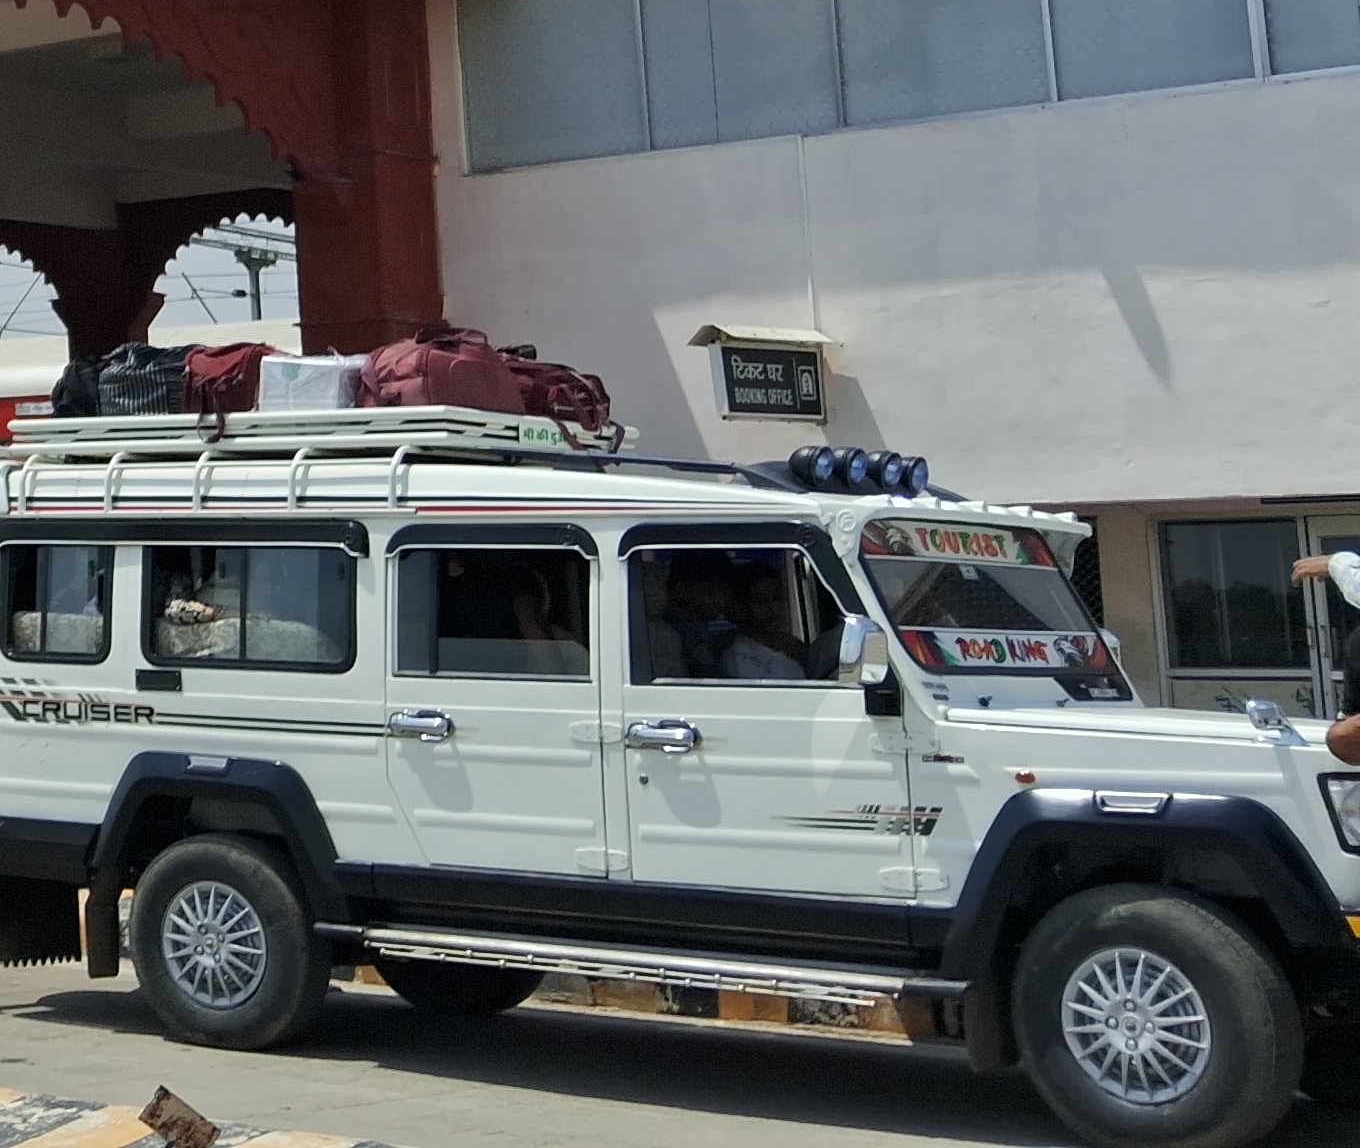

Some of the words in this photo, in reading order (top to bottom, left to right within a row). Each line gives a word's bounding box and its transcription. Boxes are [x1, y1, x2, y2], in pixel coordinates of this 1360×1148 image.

[731, 354, 765, 381] टिकट
[766, 363, 784, 382] घर
[734, 387, 767, 404] BOOKING
[768, 388, 794, 405] OFFICE
[915, 527, 1008, 559] TOURIST
[955, 636, 1006, 664] ROAD
[1006, 636, 1049, 665] KING
[22, 700, 156, 725] CRUISER
